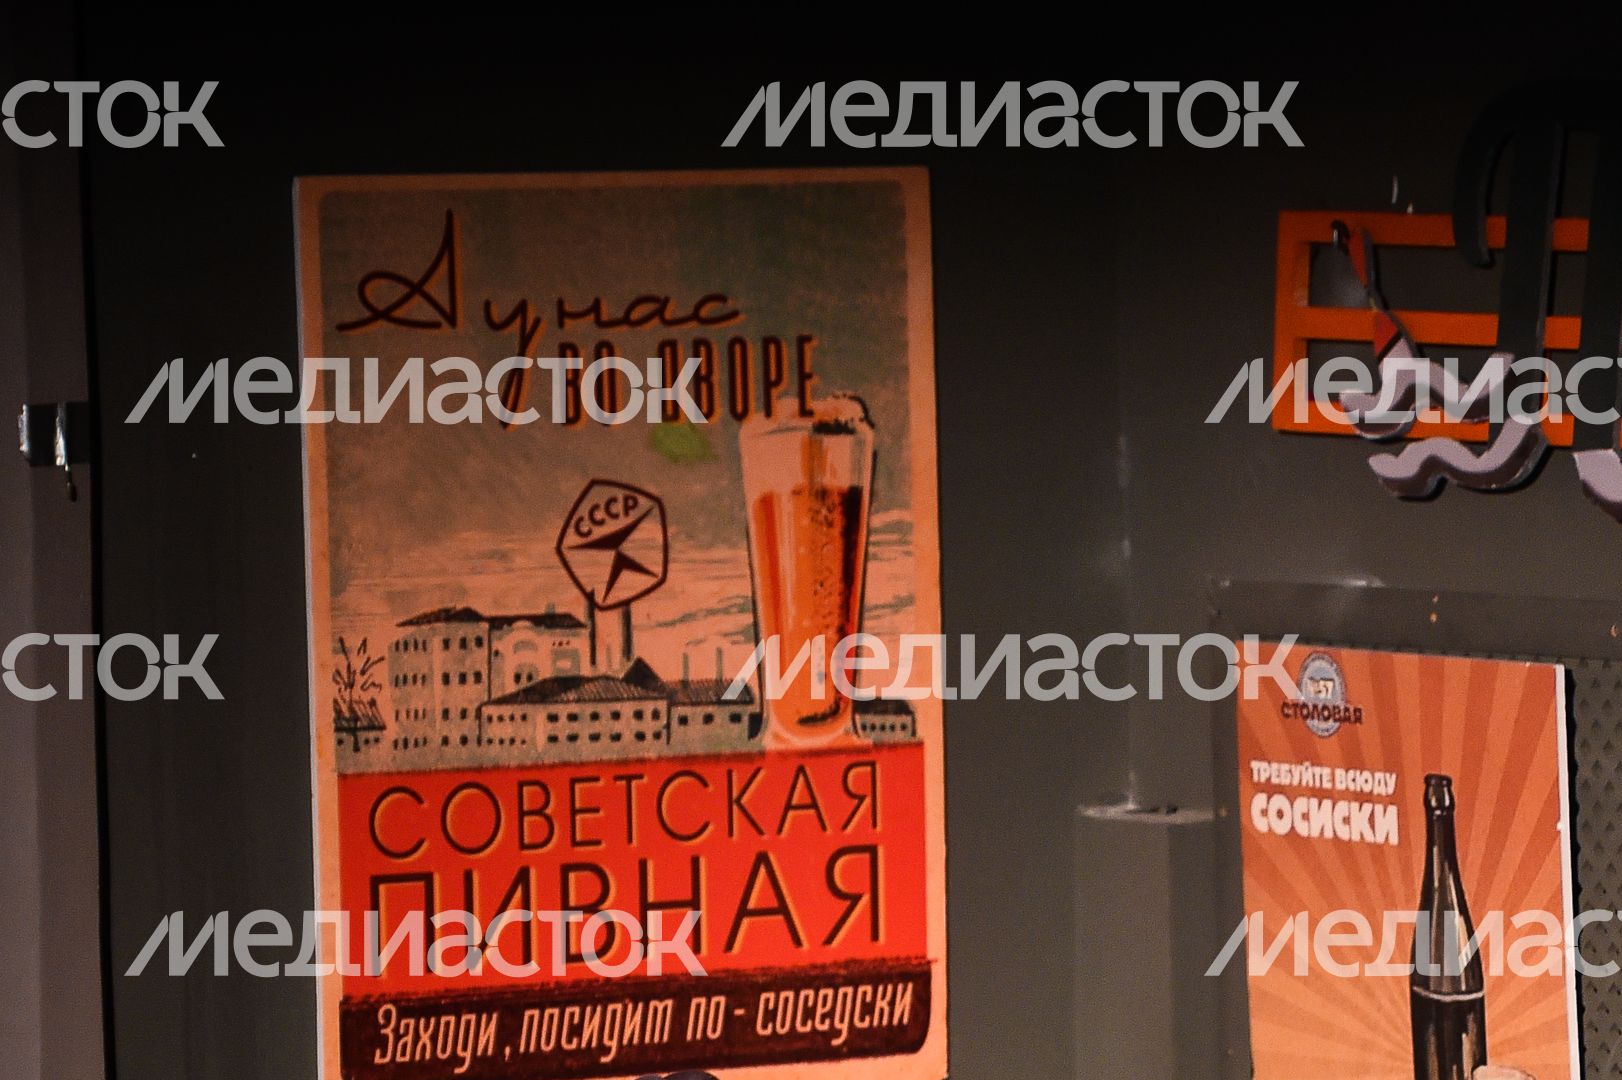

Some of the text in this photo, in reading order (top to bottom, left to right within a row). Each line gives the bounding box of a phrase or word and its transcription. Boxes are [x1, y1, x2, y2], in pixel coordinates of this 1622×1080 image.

[336, 207, 457, 330] А
[656, 333, 816, 424] ДВОРЕ
[573, 494, 640, 539] СССР
[1281, 702, 1363, 724] СТОЛОВАЯ
[368, 760, 881, 861] СОВЕТСКАЯ
[1250, 760, 1397, 796] ТРЕБУЙТЕ ВСЮДУ
[1251, 792, 1399, 846] СОСИСКИ
[369, 844, 886, 979] ПИВНАЯ
[374, 1003, 513, 1074] Заходи,
